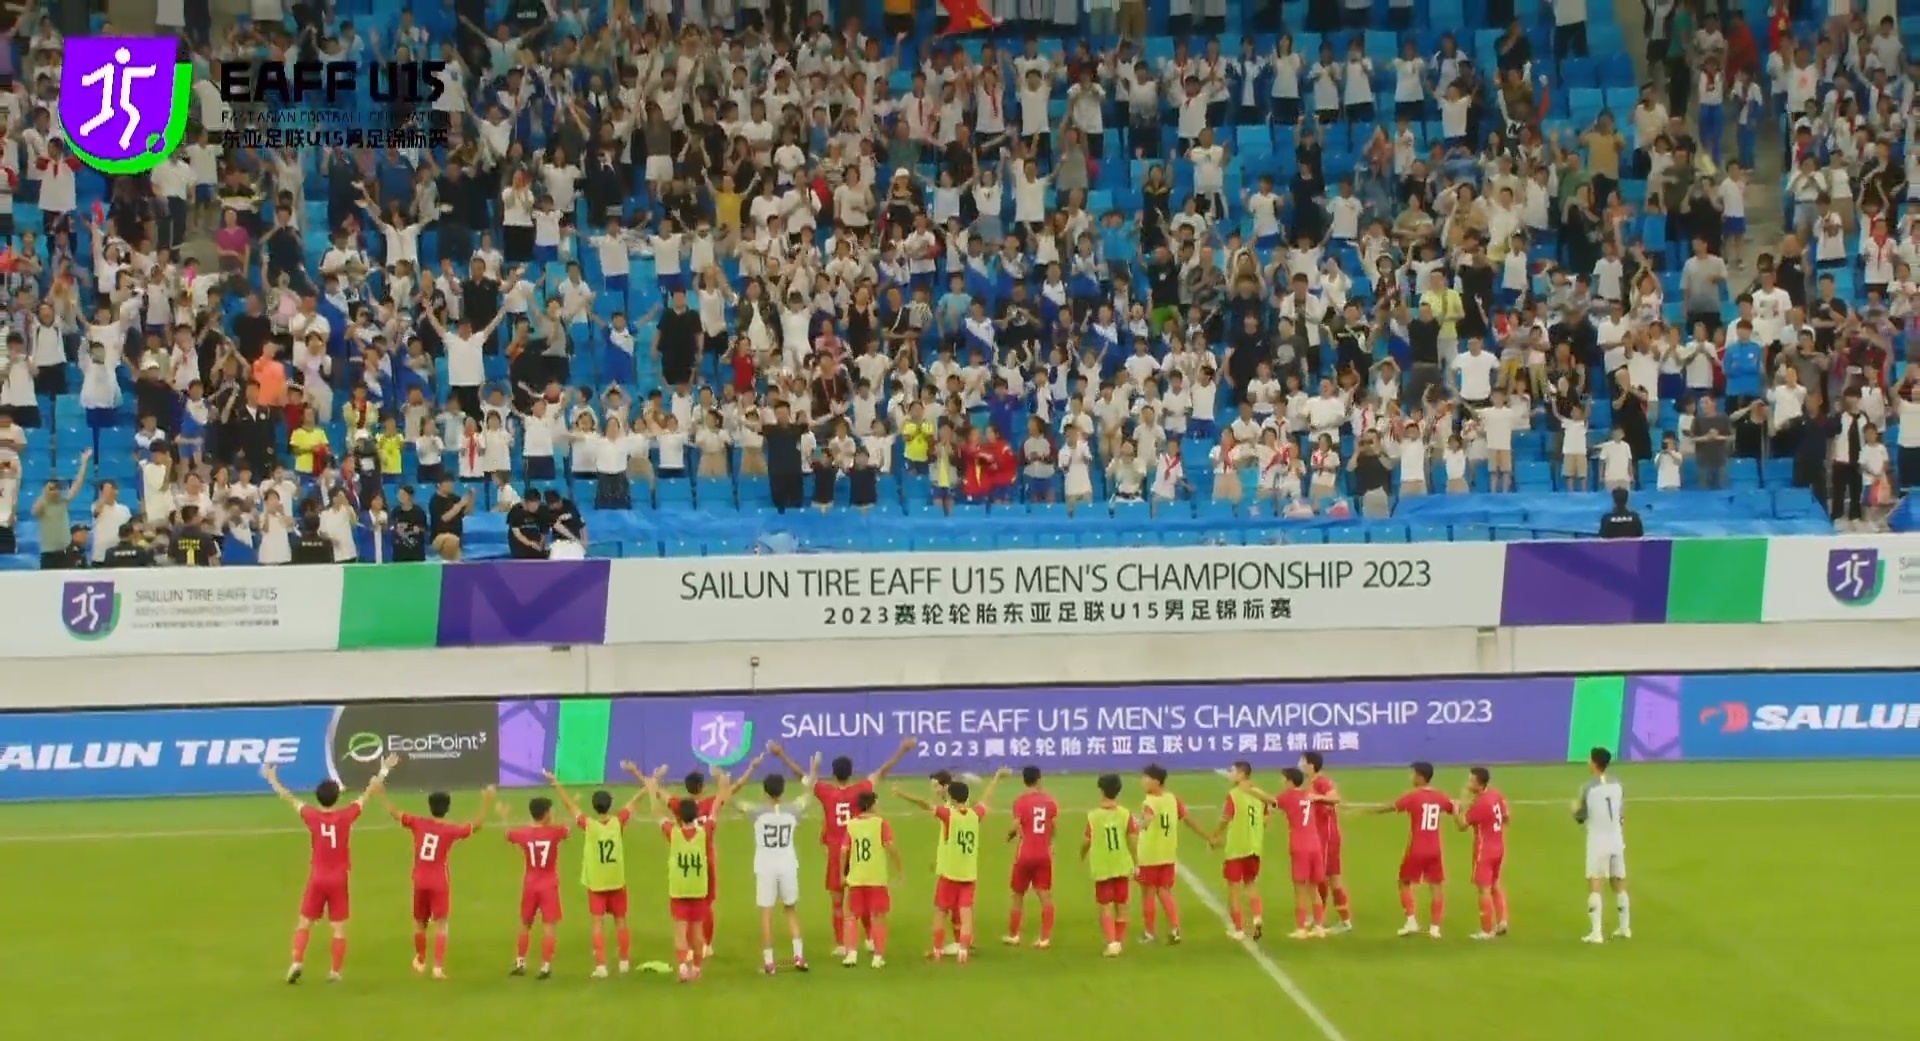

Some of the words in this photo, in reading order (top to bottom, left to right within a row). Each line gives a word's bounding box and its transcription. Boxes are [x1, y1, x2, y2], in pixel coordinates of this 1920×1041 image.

[680, 570, 789, 600] SAILUN
[797, 568, 861, 597] TIRE
[870, 567, 942, 595] EAFF
[952, 566, 1005, 594] U15
[1015, 563, 1108, 593] MEN'S
[1116, 560, 1353, 592] CHAMPIONSHIP
[1363, 560, 1431, 588] 2023
[824, 598, 1292, 625] 2023赛轮轮胎东亚足联U15男足锦标赛
[781, 712, 884, 738] SAILUN
[892, 710, 951, 735] TIRE
[960, 709, 1029, 733] EAFF
[1038, 708, 1088, 732] U15
[1098, 705, 1186, 731] MEN'S
[1194, 702, 1418, 729] CHAMPIONSHIP
[1426, 699, 1493, 725] 2023
[0, 741, 162, 770] AILUN
[175, 737, 300, 766] TIRE
[835, 803, 850, 827] 5
[1033, 807, 1046, 834] 2
[1299, 800, 1311, 826] 7
[1421, 803, 1440, 831] 18
[1493, 802, 1504, 831] 3
[1605, 797, 1613, 821] 1
[320, 823, 337, 849] 4
[763, 823, 791, 849] 20
[1160, 812, 1170, 837] 4
[420, 833, 439, 862] 8
[598, 840, 616, 864] 12
[855, 838, 871, 862] 18
[1106, 827, 1119, 851] 11
[527, 841, 551, 868] 17
[677, 852, 702, 878] 44
